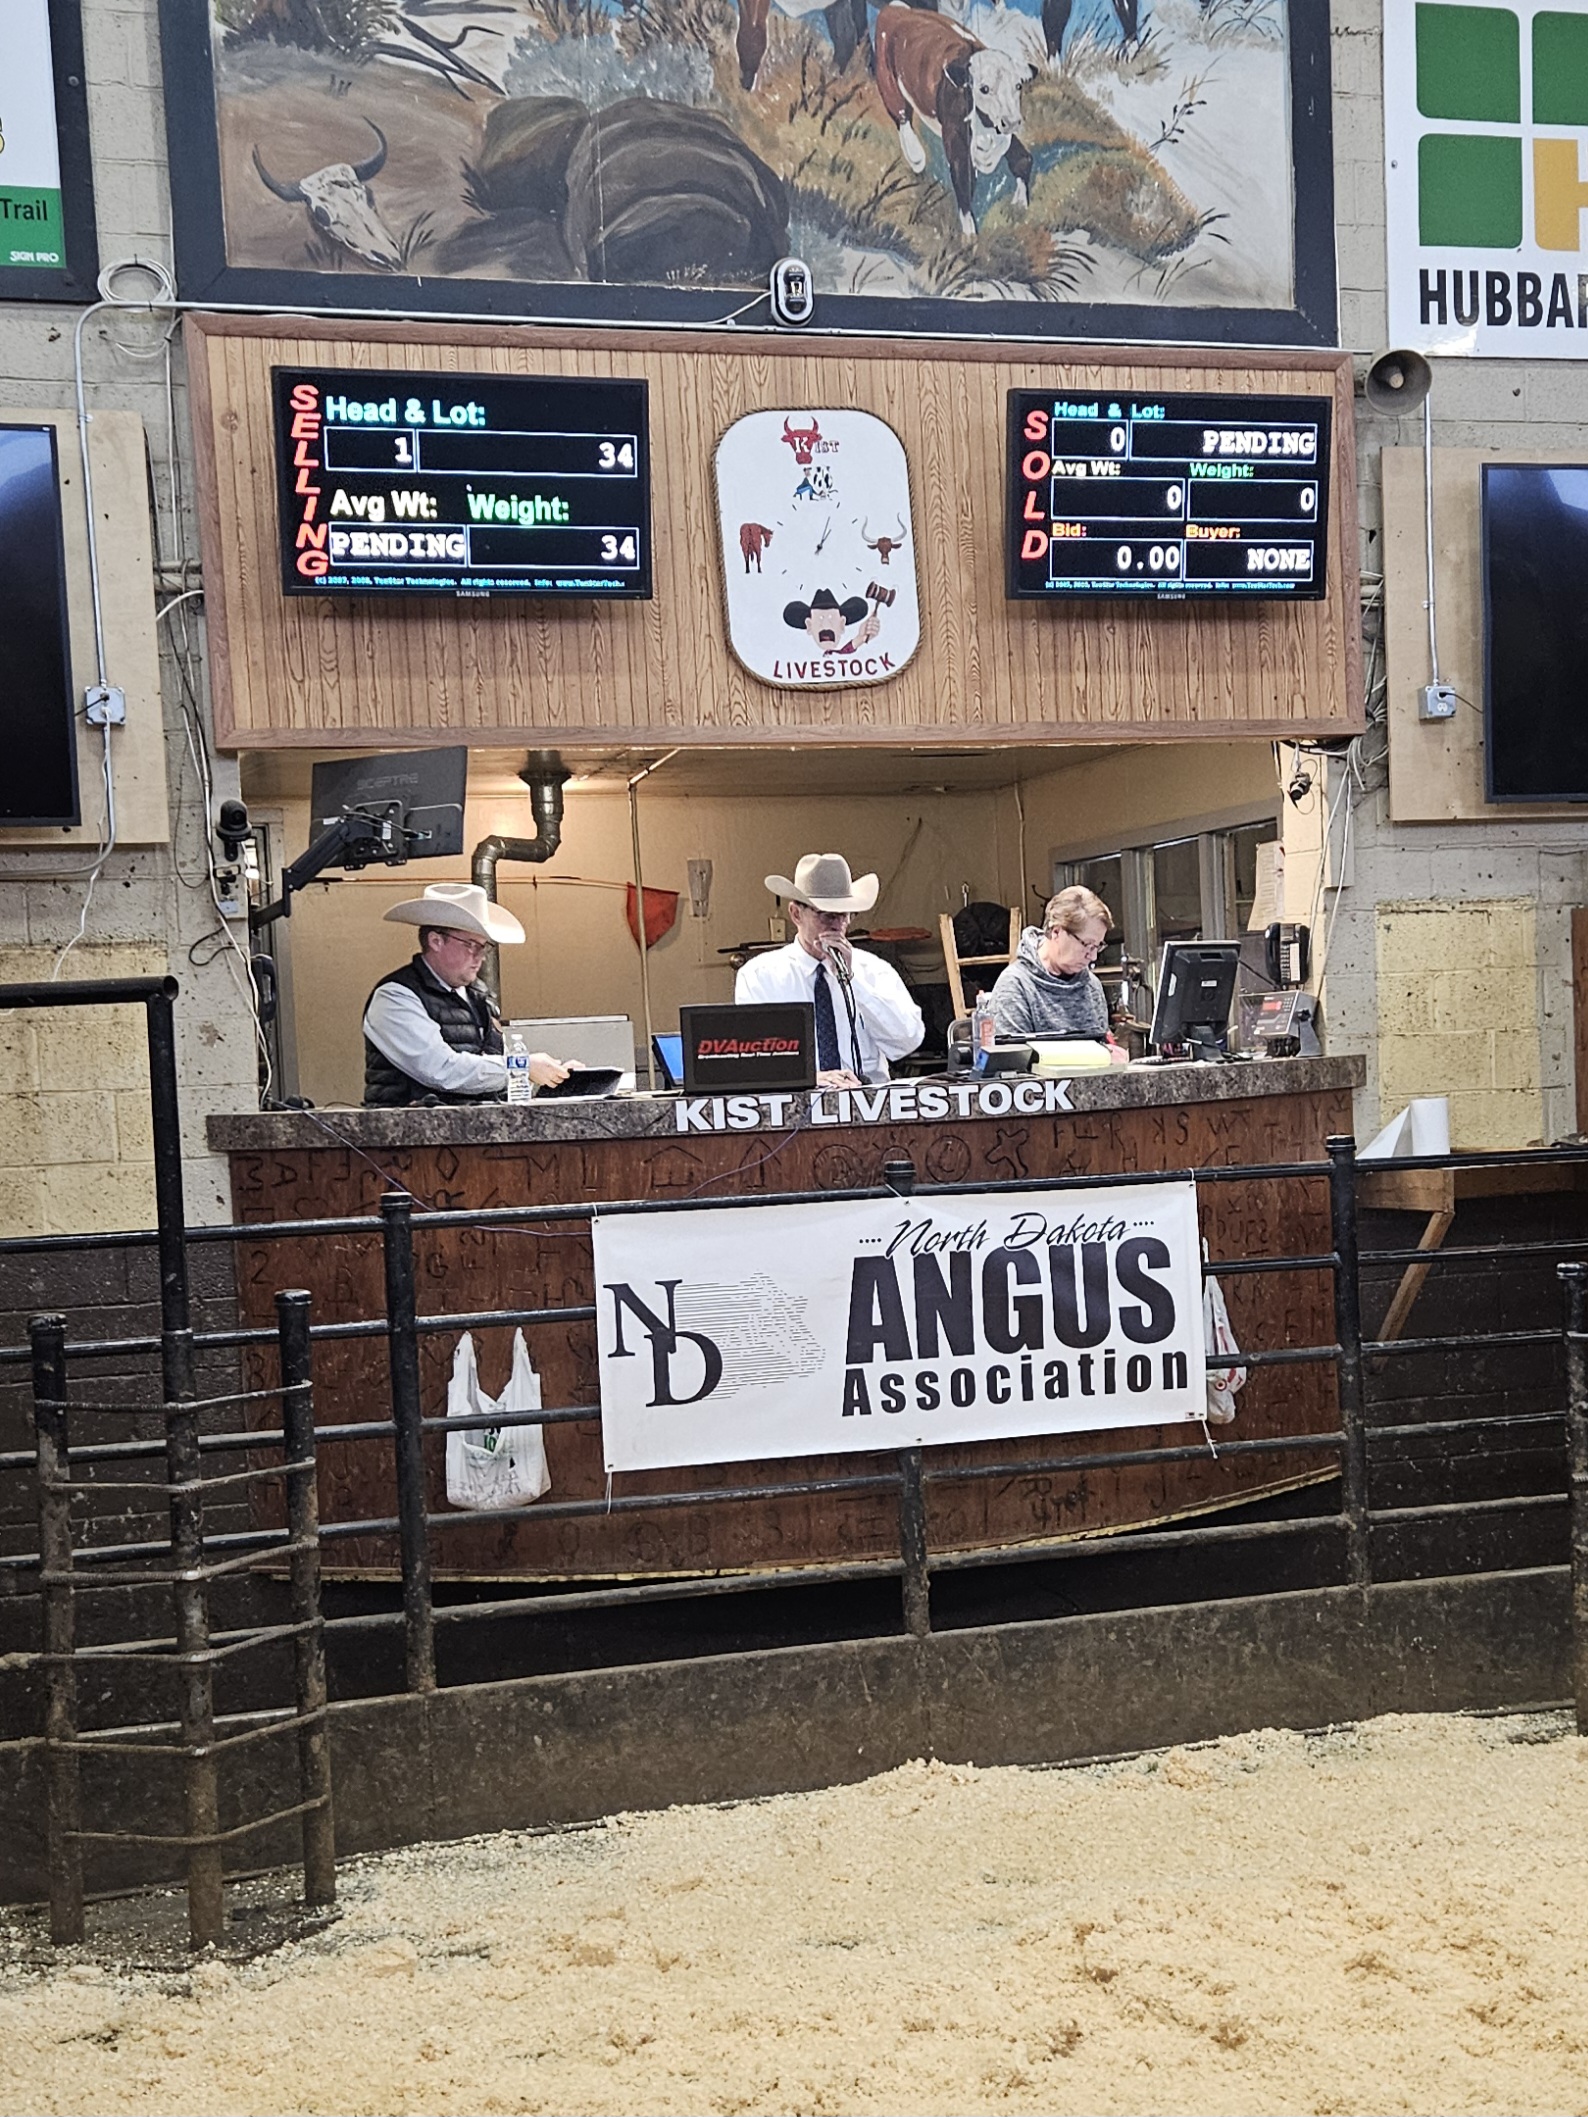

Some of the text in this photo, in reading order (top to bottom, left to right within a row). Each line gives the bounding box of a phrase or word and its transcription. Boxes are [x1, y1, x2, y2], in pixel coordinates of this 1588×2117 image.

[0, 198, 48, 221] Trail
[10, 251, 59, 262] SIGN PRO
[325, 396, 486, 426] Head & Lot:
[1054, 402, 1166, 419] Head & Lot:
[394, 437, 412, 463] 1
[1111, 427, 1125, 451] 0
[1202, 430, 1316, 455] PENDING
[599, 442, 634, 468] 34
[290, 384, 329, 576] SELLING
[1052, 460, 1121, 477] Avg Wt:
[1189, 463, 1254, 478] Weight:
[1021, 410, 1050, 560] SOLD
[1167, 485, 1182, 510] 0
[330, 489, 437, 521] Avg Wt:
[468, 493, 570, 525] Weight:
[1300, 487, 1315, 511] 0
[1052, 523, 1087, 538] Bid:
[1185, 524, 1240, 540] Buyer:
[330, 532, 465, 559] PENDING
[600, 535, 635, 560] 34
[1117, 546, 1180, 570] 0.00
[1247, 548, 1311, 571] NONE
[456, 590, 490, 598] SAMSUNG
[774, 652, 895, 679] LIVESTOCK
[697, 1037, 800, 1054] DVAuction
[675, 1079, 1076, 1132] KIST LIVESTOCK
[886, 1213, 1131, 1258] North Dakota
[845, 1236, 1176, 1365] ANGUS
[842, 1348, 1189, 1416] Association
